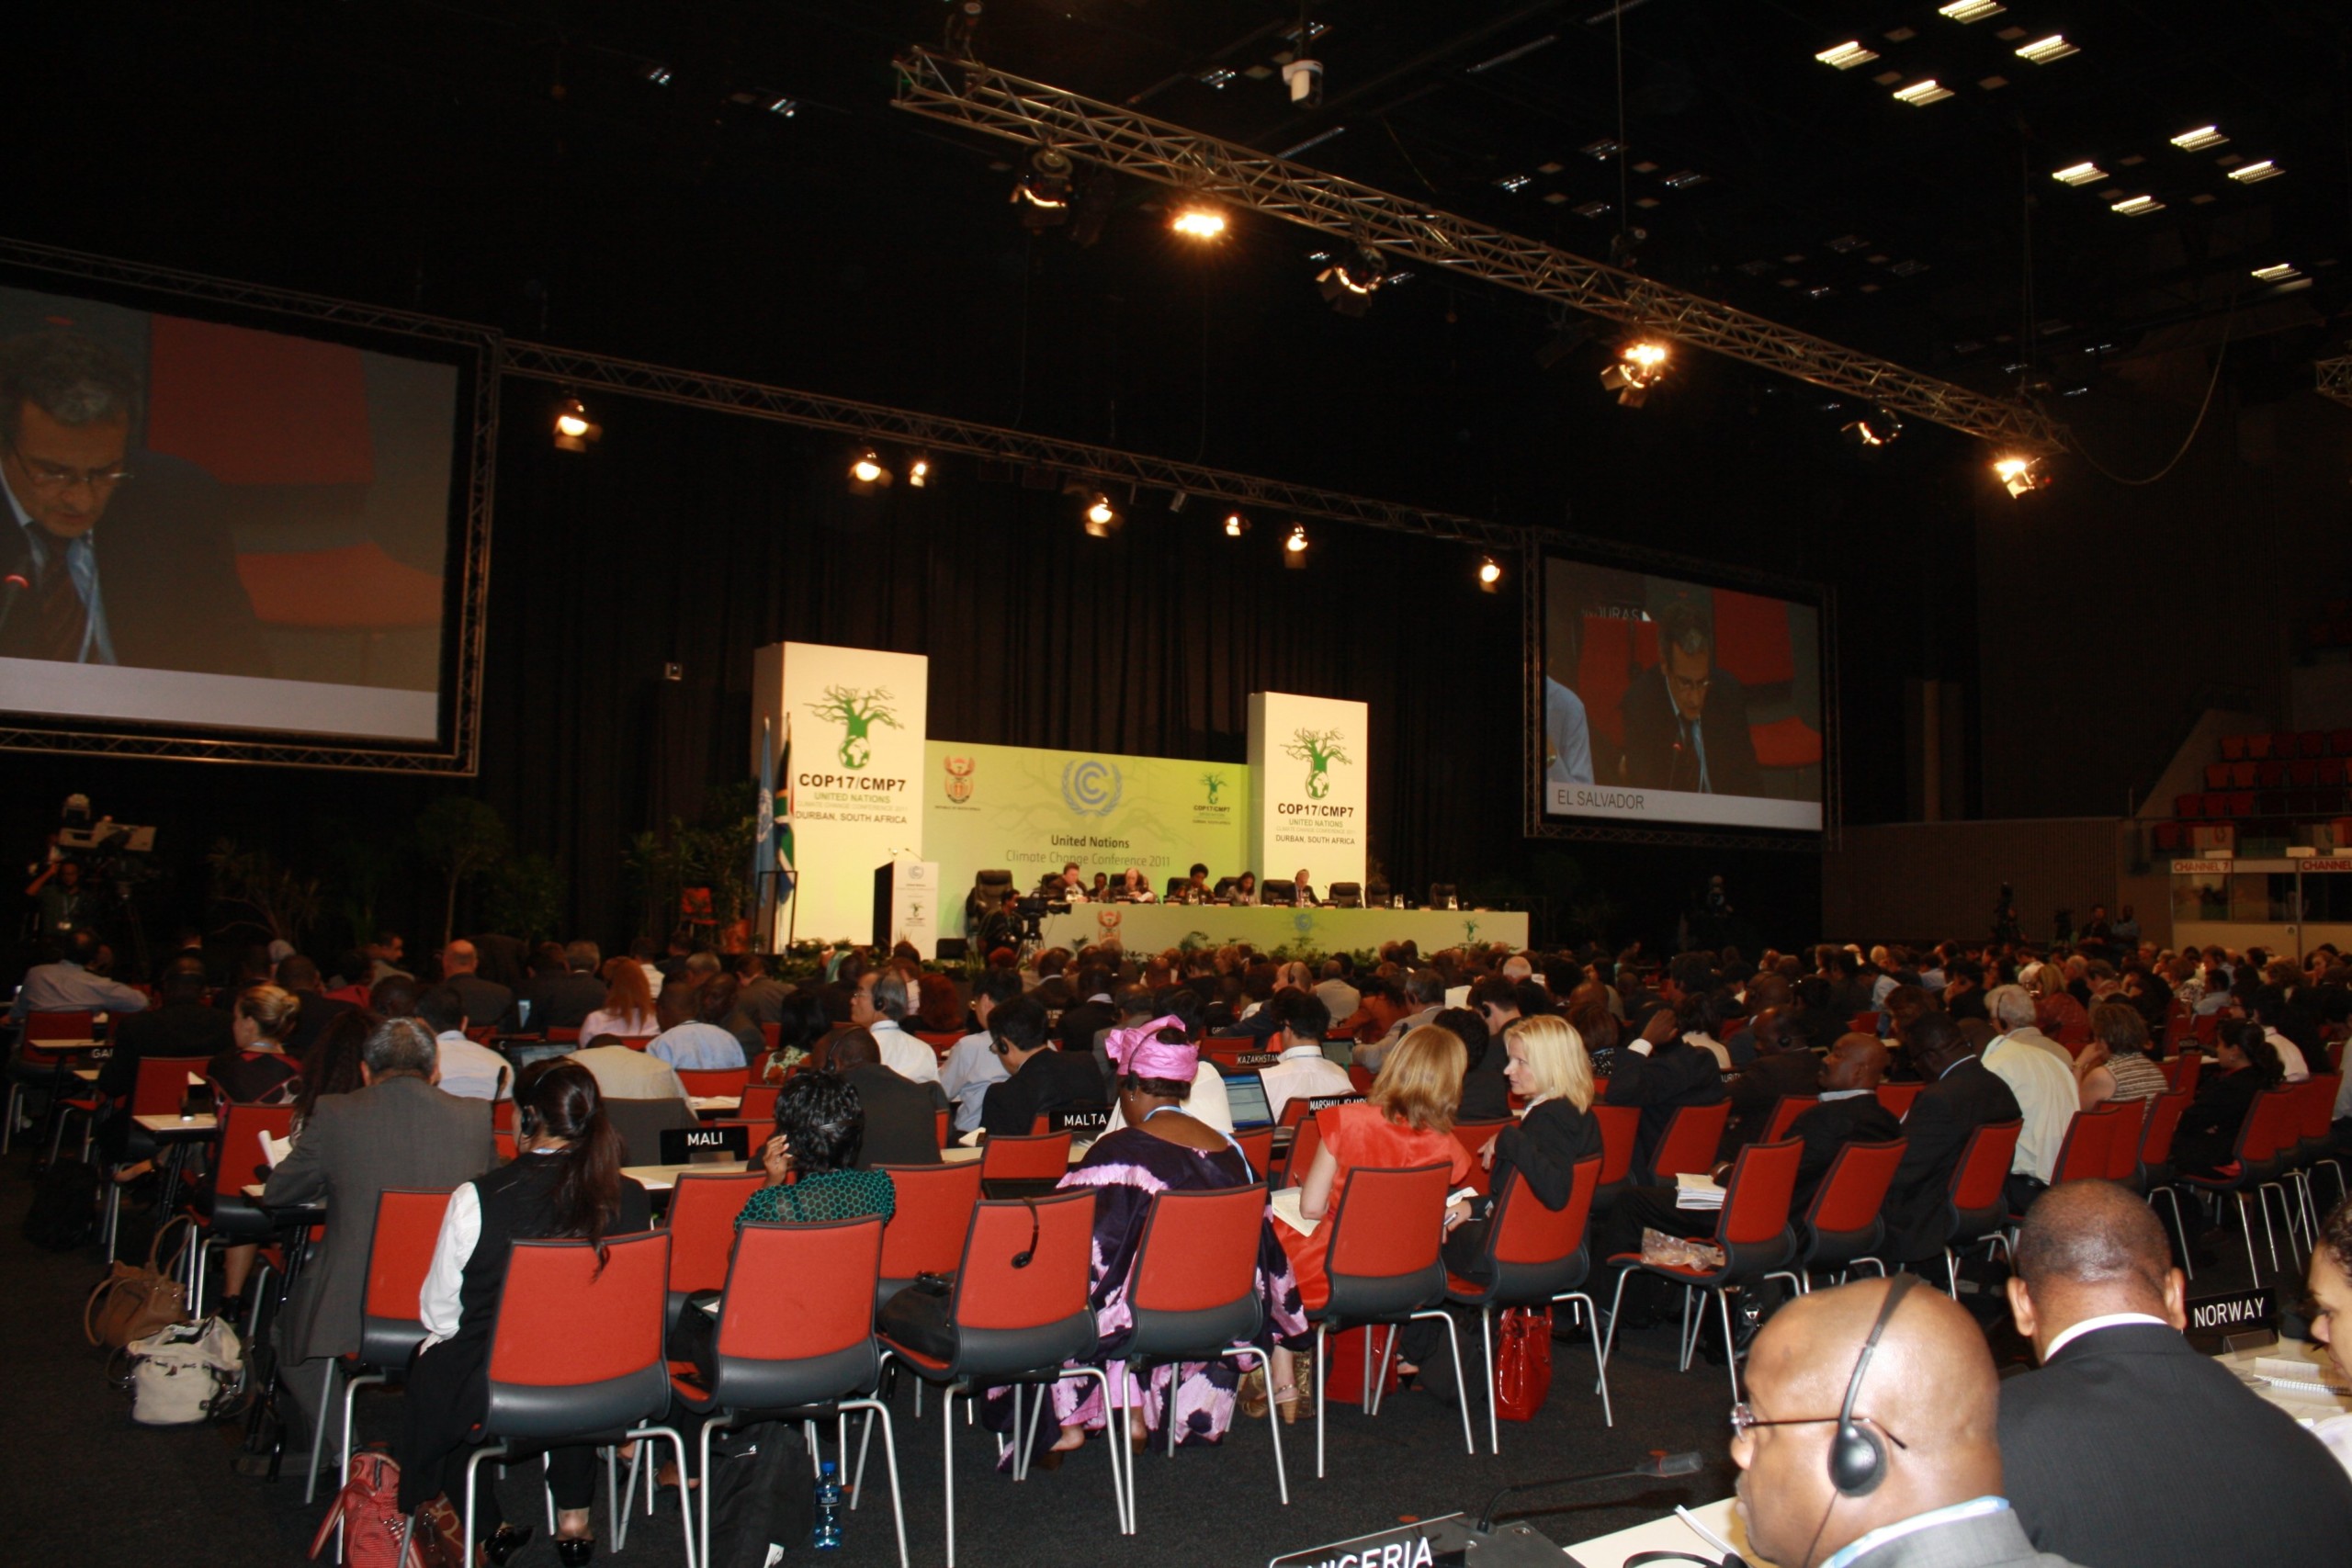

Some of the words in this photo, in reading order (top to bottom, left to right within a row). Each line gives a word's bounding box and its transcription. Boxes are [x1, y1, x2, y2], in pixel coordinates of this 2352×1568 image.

[798, 773, 907, 792] COP17/CMP7
[814, 792, 849, 802] UNITED
[851, 794, 891, 804] NATIONS
[1557, 789, 1574, 806] EL
[1577, 790, 1645, 809] SALVADOR
[1278, 803, 1354, 818] COP17/CMP7
[840, 813, 872, 823] SOUTH
[874, 815, 908, 825] AFRICA
[1289, 818, 1313, 827] UNITED
[1315, 819, 1343, 829] NATIONS
[1051, 834, 1086, 847] United
[1090, 836, 1130, 849] Nations
[1307, 836, 1329, 844] SOUTH
[1331, 837, 1355, 845] AFRICA
[1006, 850, 1046, 863] Climate
[1049, 852, 1089, 865] Change
[1091, 852, 1147, 866] Conference
[1149, 855, 1170, 867] 2011
[2174, 862, 2219, 872] CHANNEL
[1237, 1054, 1279, 1065] KAZAKHSTAN
[1309, 1100, 1340, 1111] MARSHALL
[1064, 1112, 1107, 1126] MALTA
[687, 1131, 723, 1146] MALI
[2194, 1297, 2264, 1328] NORWAY
